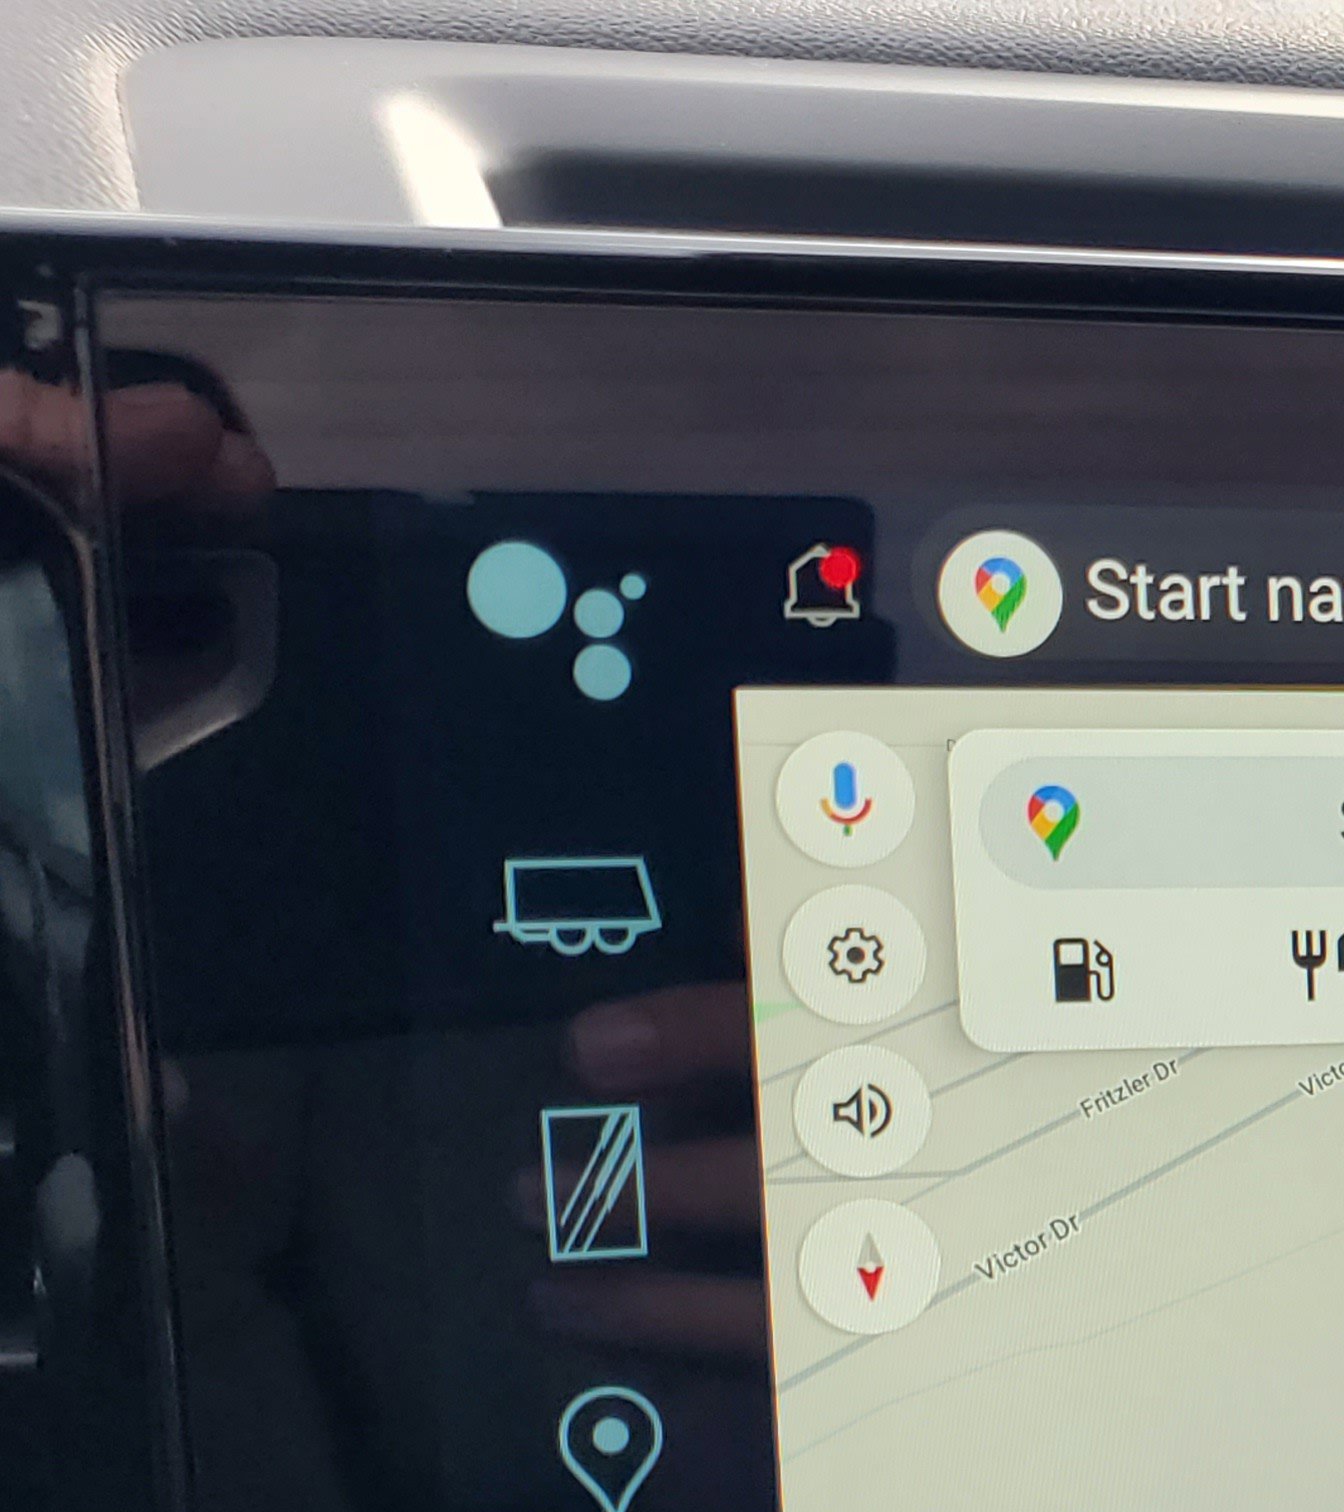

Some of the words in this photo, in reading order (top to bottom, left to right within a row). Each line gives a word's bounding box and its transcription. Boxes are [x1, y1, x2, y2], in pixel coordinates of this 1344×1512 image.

[1085, 557, 1248, 623] Start
[1079, 1071, 1151, 1119] Fritzler
[1153, 1057, 1179, 1081] Dr
[973, 1233, 1048, 1281] Victor
[1050, 1212, 1080, 1242] Dr
